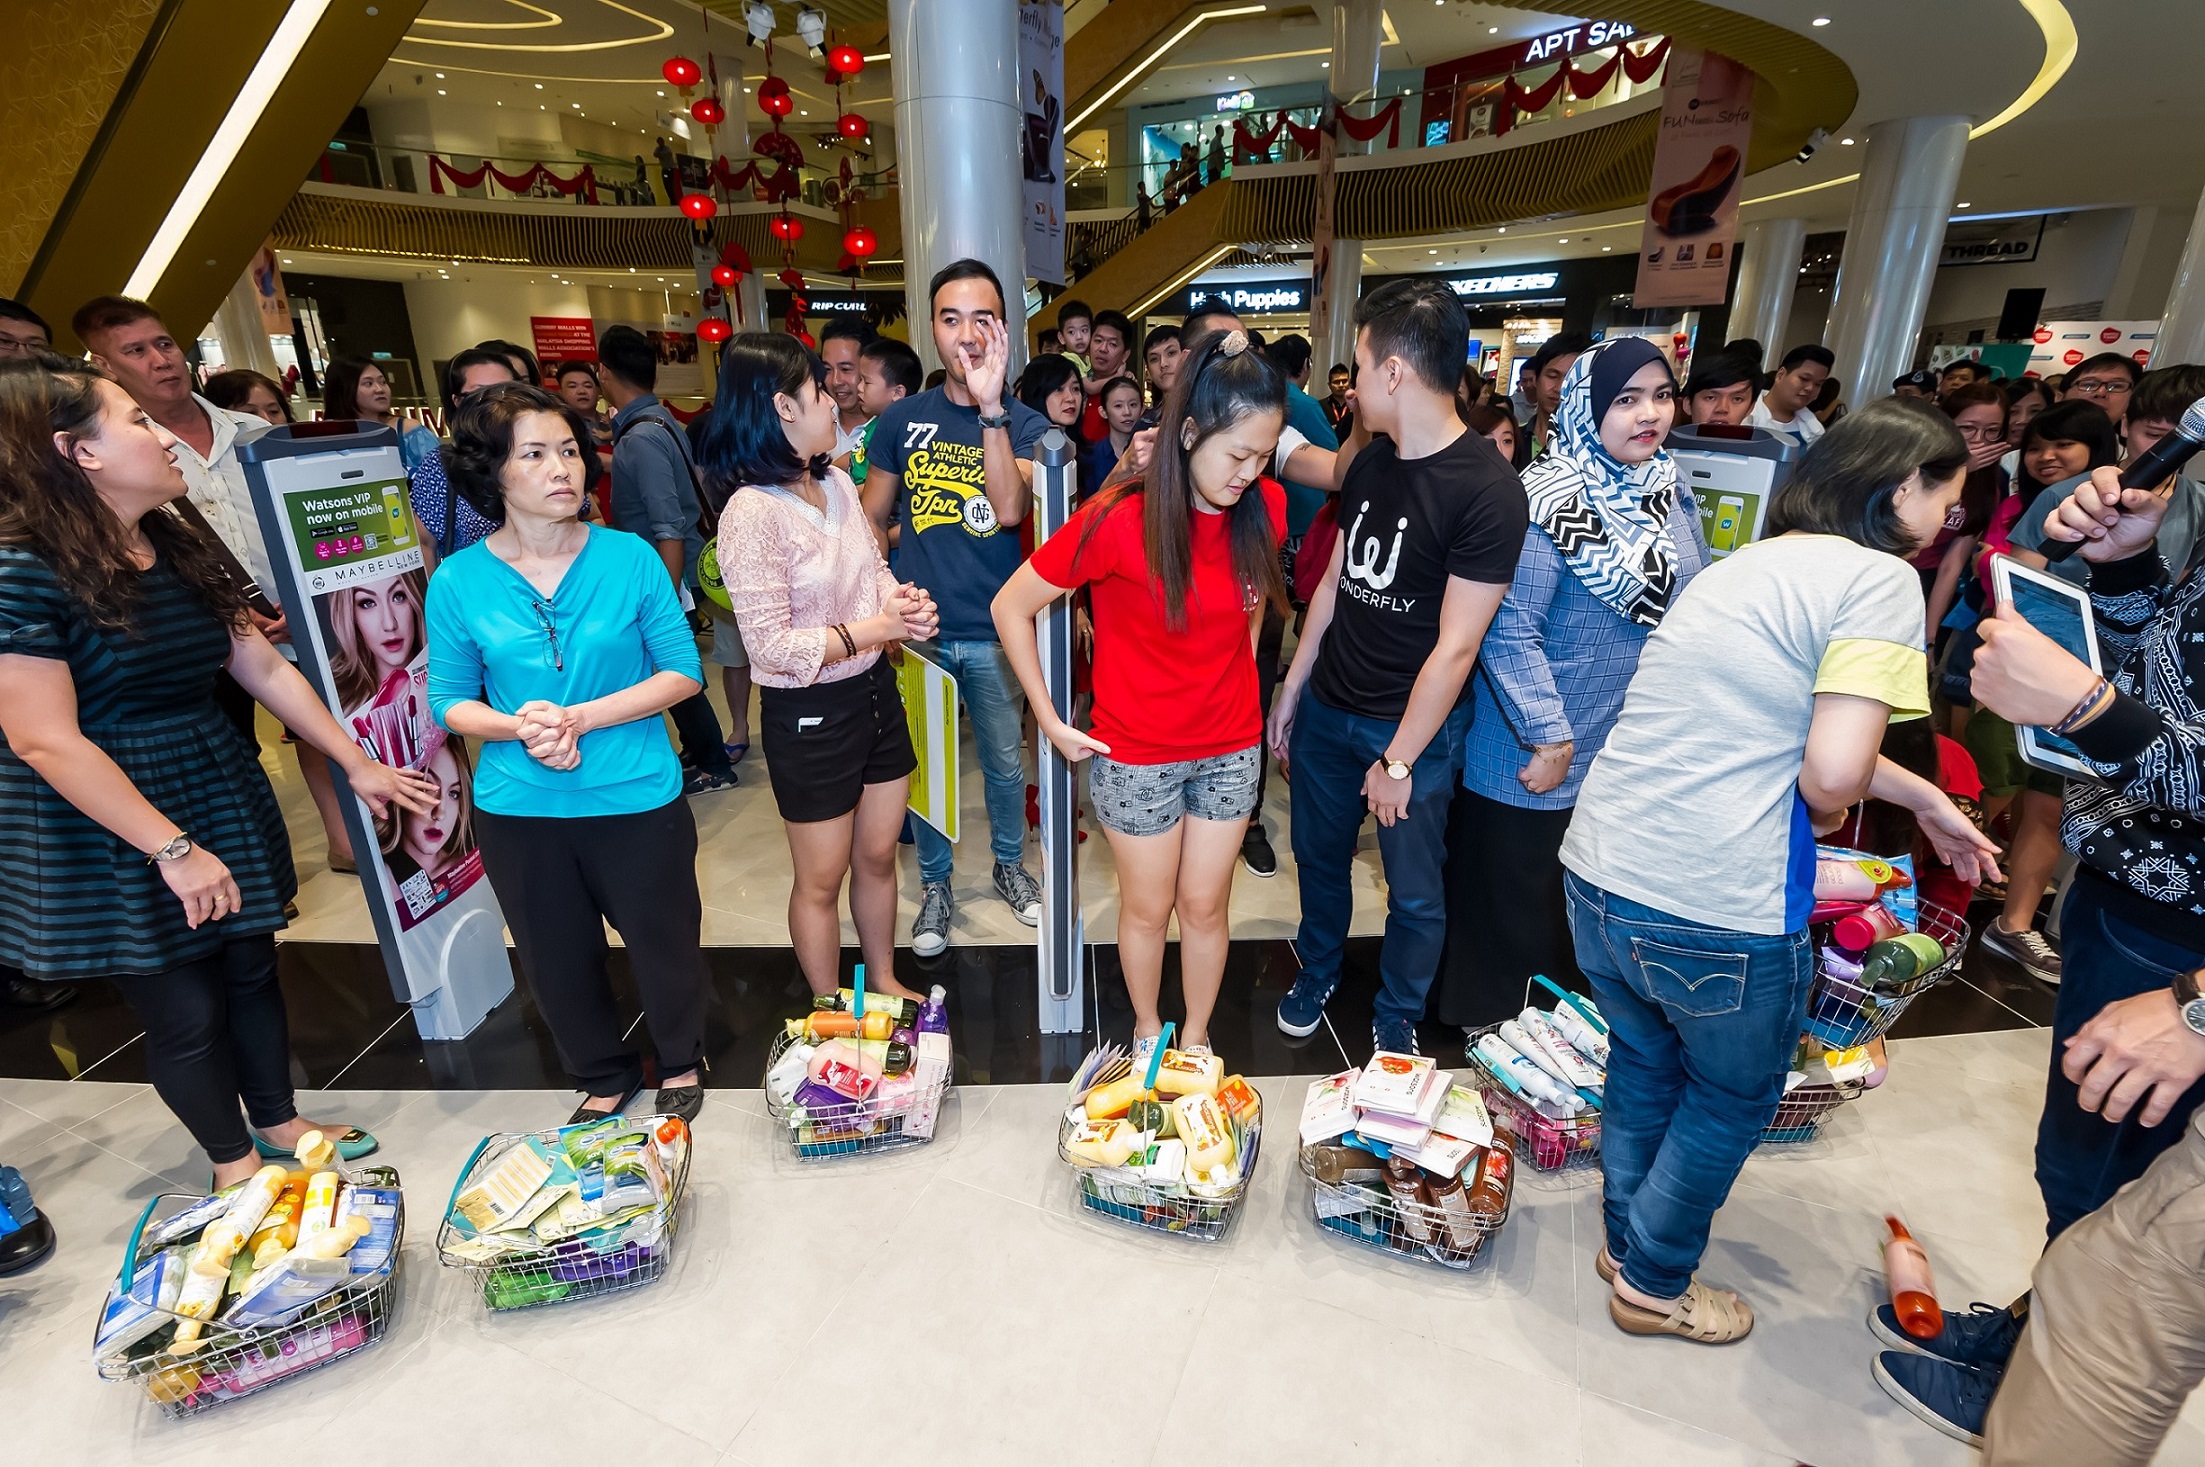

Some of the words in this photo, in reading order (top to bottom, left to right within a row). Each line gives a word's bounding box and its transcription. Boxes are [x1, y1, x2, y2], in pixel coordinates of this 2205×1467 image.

[1525, 28, 1581, 62] APT
[1716, 106, 1750, 126] Sofa
[1949, 242, 2029, 258] THREAD
[1449, 273, 1558, 295] KECHERS
[811, 302, 834, 310] RIP
[834, 302, 867, 311] CURL
[1191, 290, 1232, 310] Hh
[1234, 288, 1300, 311] Puppies
[904, 421, 939, 449] 77
[931, 440, 984, 458] VINTAGE
[933, 452, 978, 466] ATHLETIC
[302, 496, 353, 512] Watsons
[354, 492, 371, 504] VIP
[306, 513, 333, 525] now
[335, 510, 350, 521] on
[352, 503, 384, 518] mobile
[335, 550, 420, 581] MAYBELLINE
[1340, 576, 1415, 612] ONDERFLY
[1406, 1073, 1422, 1096] watsons
